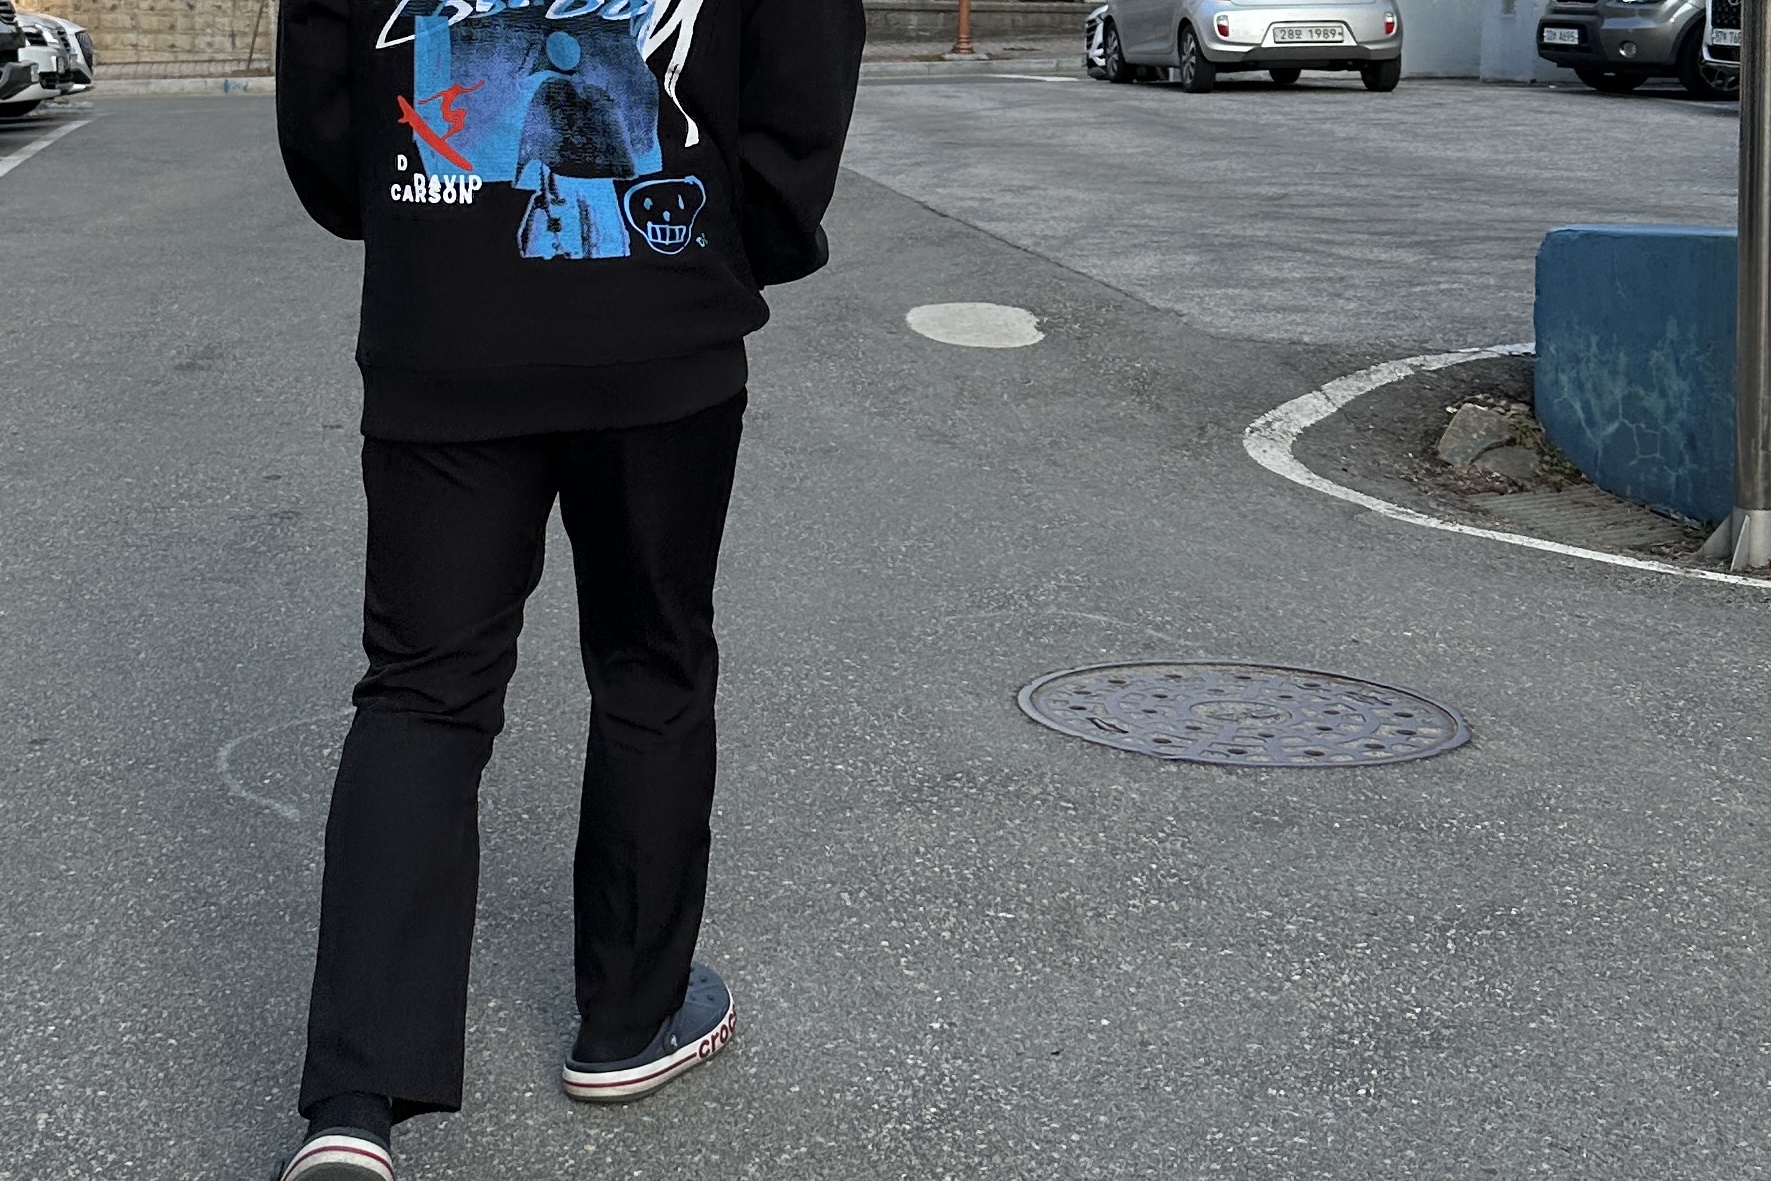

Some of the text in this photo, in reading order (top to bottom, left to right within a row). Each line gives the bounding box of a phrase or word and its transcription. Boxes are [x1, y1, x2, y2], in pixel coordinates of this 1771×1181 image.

[1308, 28, 1337, 40] 1989
[397, 154, 408, 171] D
[390, 184, 473, 204] CARSON
[698, 1003, 738, 1059] croc
